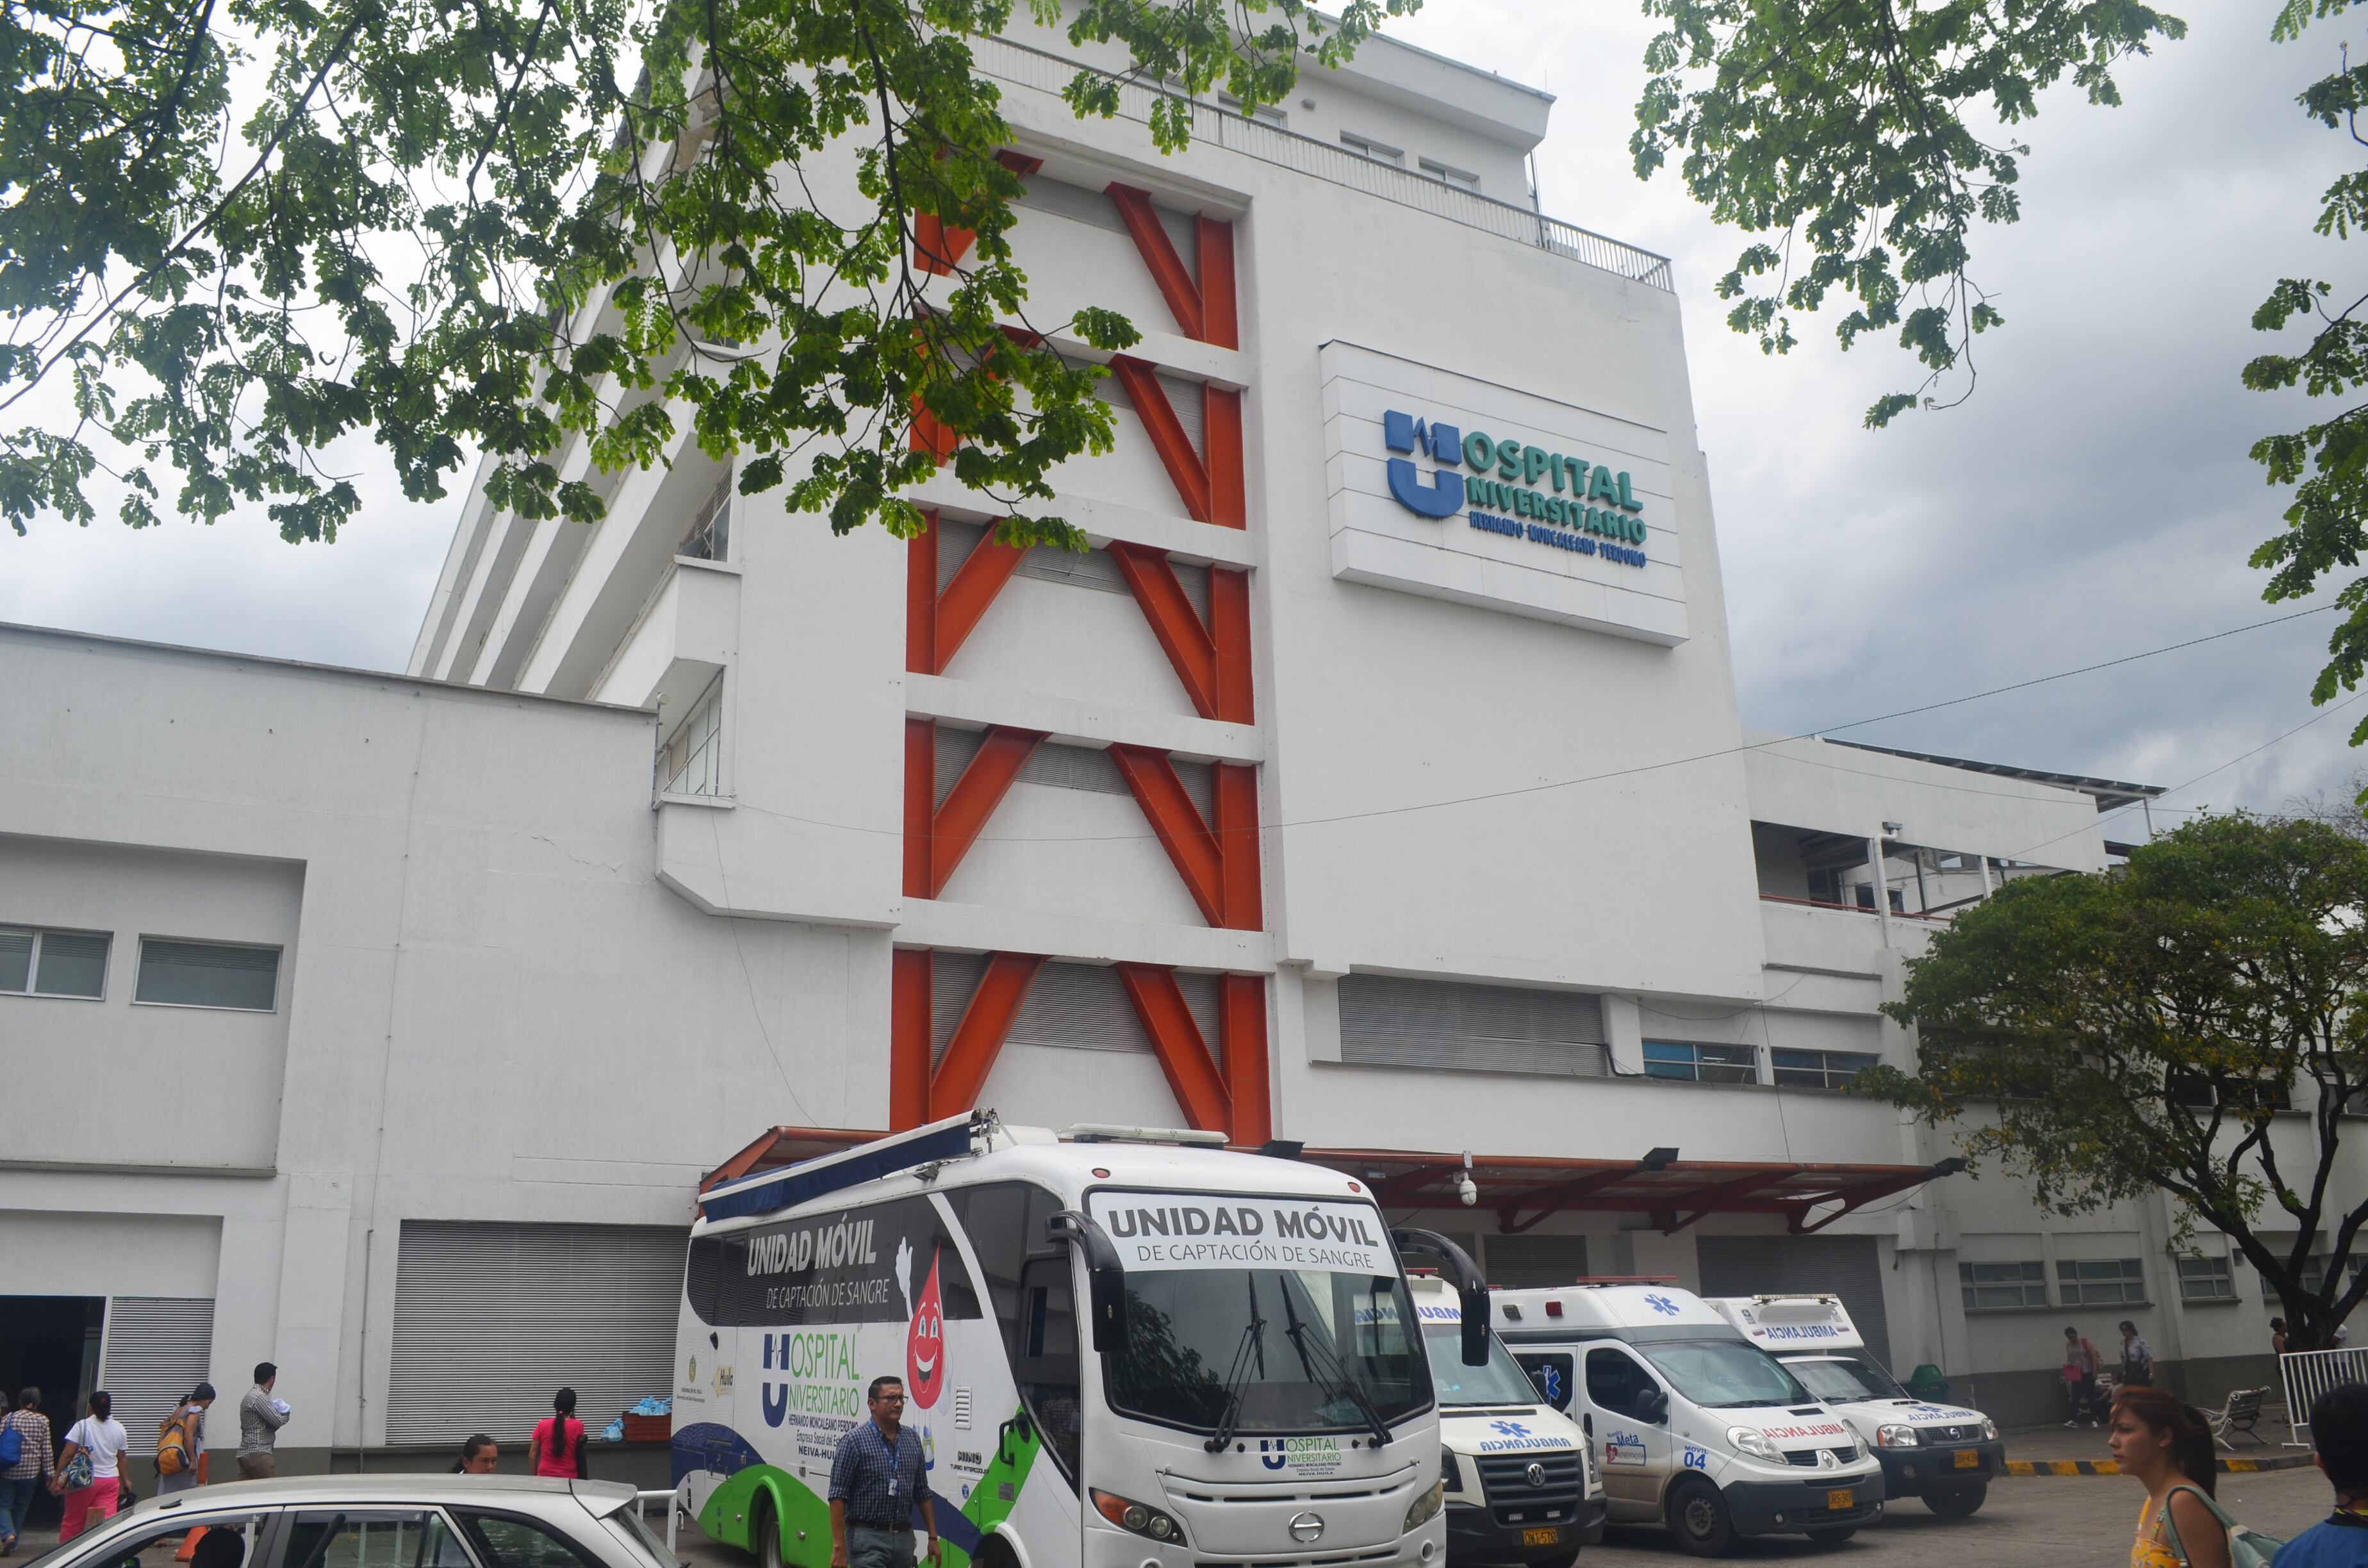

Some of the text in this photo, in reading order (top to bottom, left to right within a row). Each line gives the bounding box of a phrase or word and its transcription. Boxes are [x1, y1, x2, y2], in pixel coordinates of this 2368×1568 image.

[1469, 510, 1647, 568] HERNANDO MONCALEANO PERDOMO
[1114, 1205, 1379, 1248] UNIDAD MÓVIL
[747, 1212, 877, 1277] UNIDAD MÓVIL
[1137, 1239, 1374, 1268] DE CAPTACIÓN DE SANGRE
[766, 1278, 890, 1309] DE CAPTACIÓN DE SANGRE
[789, 1414, 809, 1427] HERNANDO
[809, 1416, 837, 1431] MONCALEANO
[796, 1429, 813, 1444] Empresa
[814, 1432, 825, 1445] Social
[1616, 1433, 1639, 1447] Meta
[957, 1450, 982, 1465] HINO
[1684, 1446, 1708, 1455] MOVIL
[1684, 1451, 1706, 1470] 04
